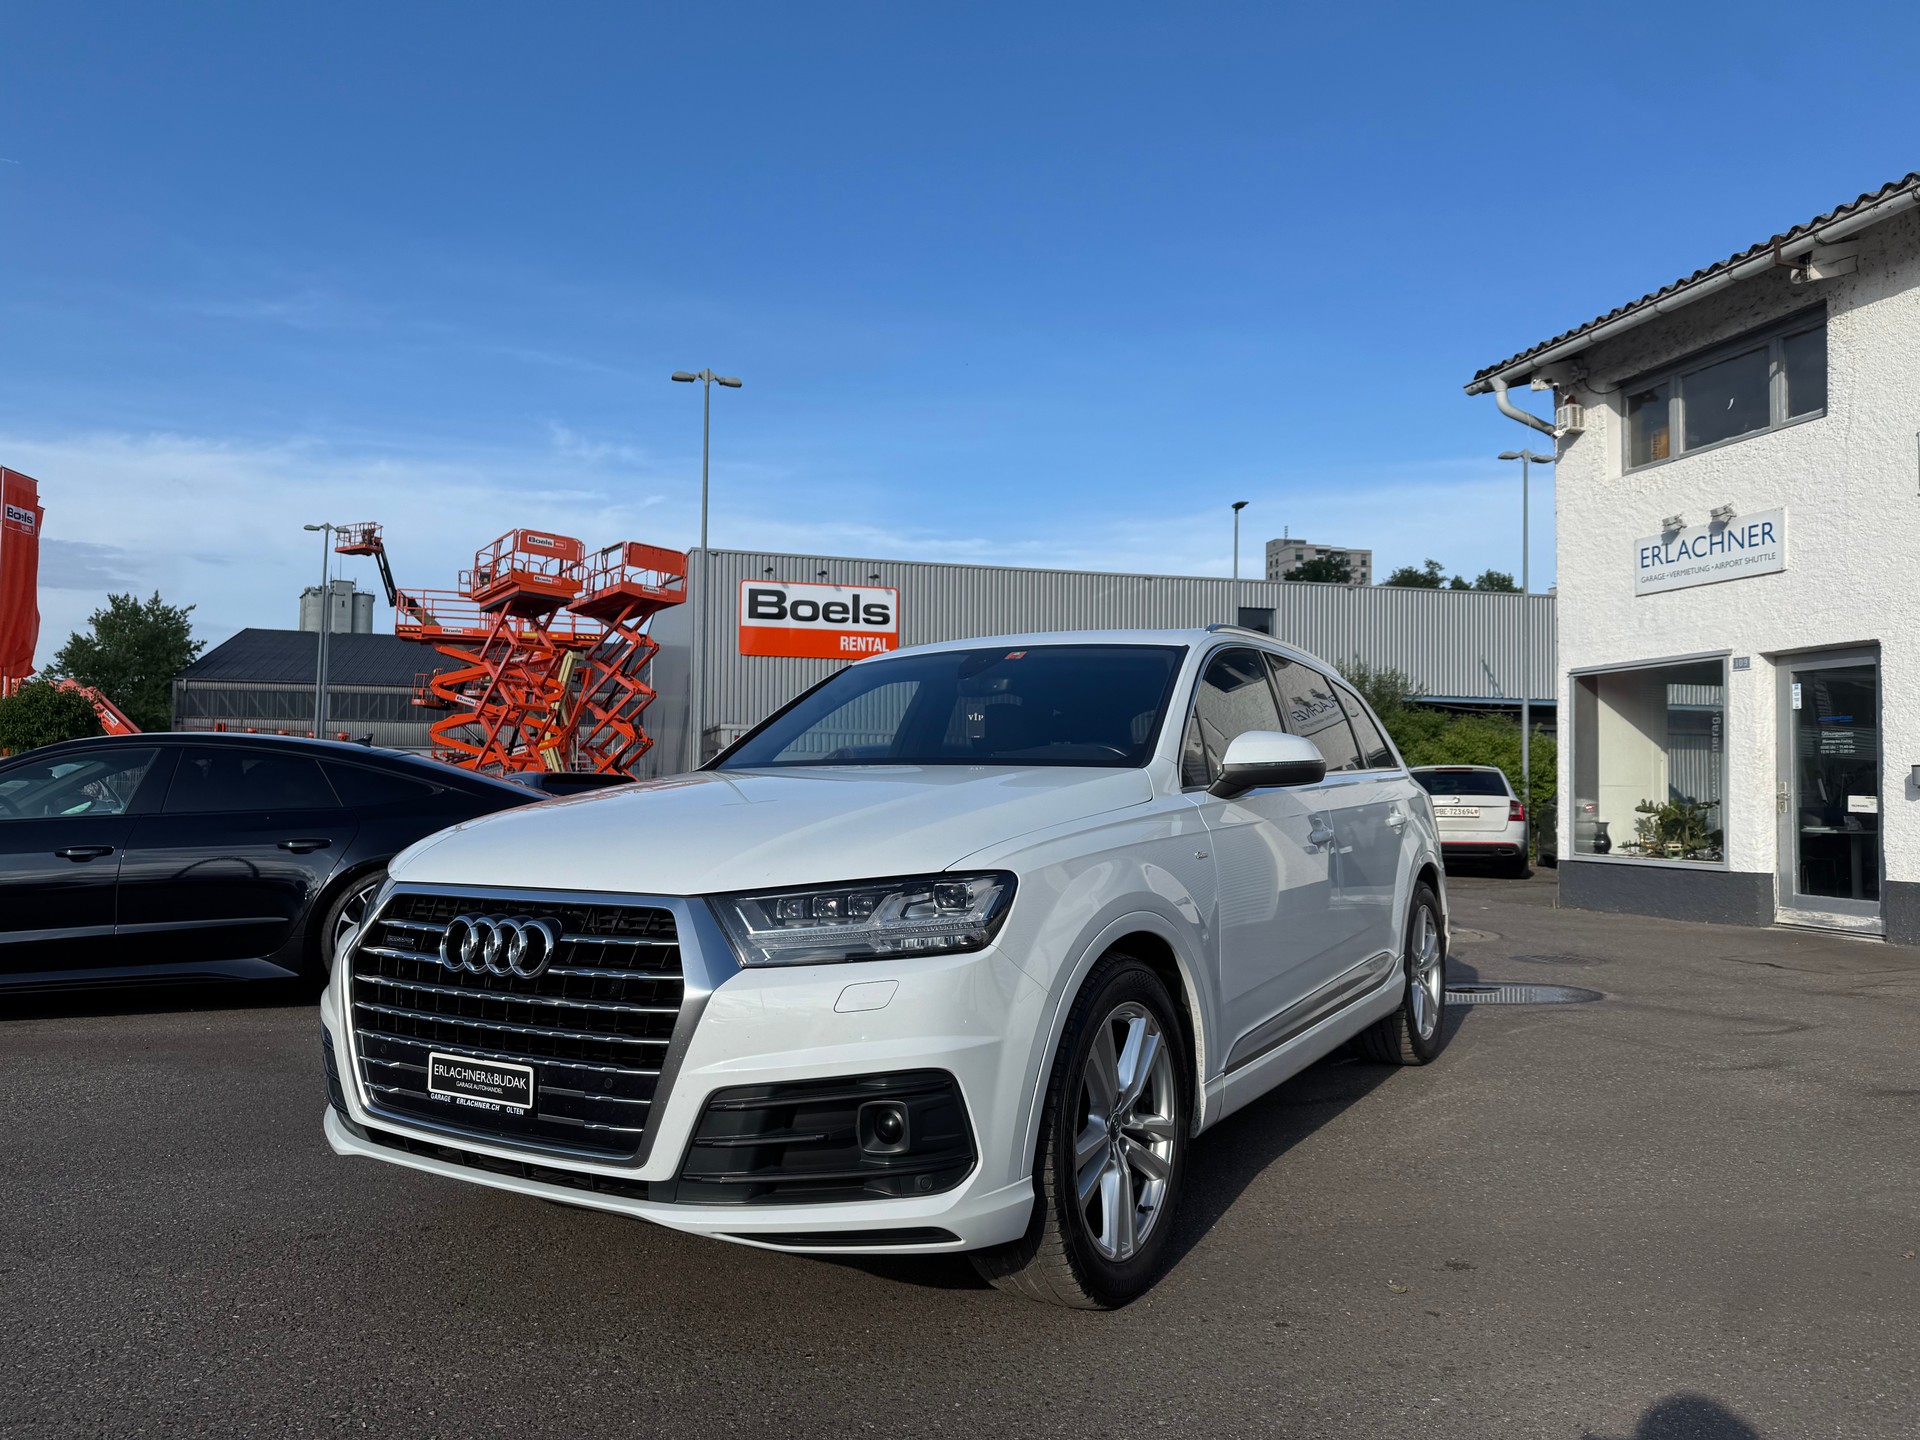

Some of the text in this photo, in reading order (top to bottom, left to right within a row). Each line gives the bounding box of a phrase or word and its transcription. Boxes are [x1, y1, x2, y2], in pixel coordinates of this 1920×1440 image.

[528, 536, 553, 546] Boels
[1640, 522, 1776, 568] ERLACHNER
[1641, 551, 1777, 584] GARAGE VERMIETUNG AIRPORT SHUTTLE
[748, 588, 891, 625] Boels
[839, 635, 890, 652] RENTAL
[434, 1064, 527, 1089] ERLACHNER&BUDAK
[455, 1081, 503, 1094] GARAGE AUTOHANDEL
[430, 1093, 525, 1116] GARAGE ERLACHNER.CH OLTEN
